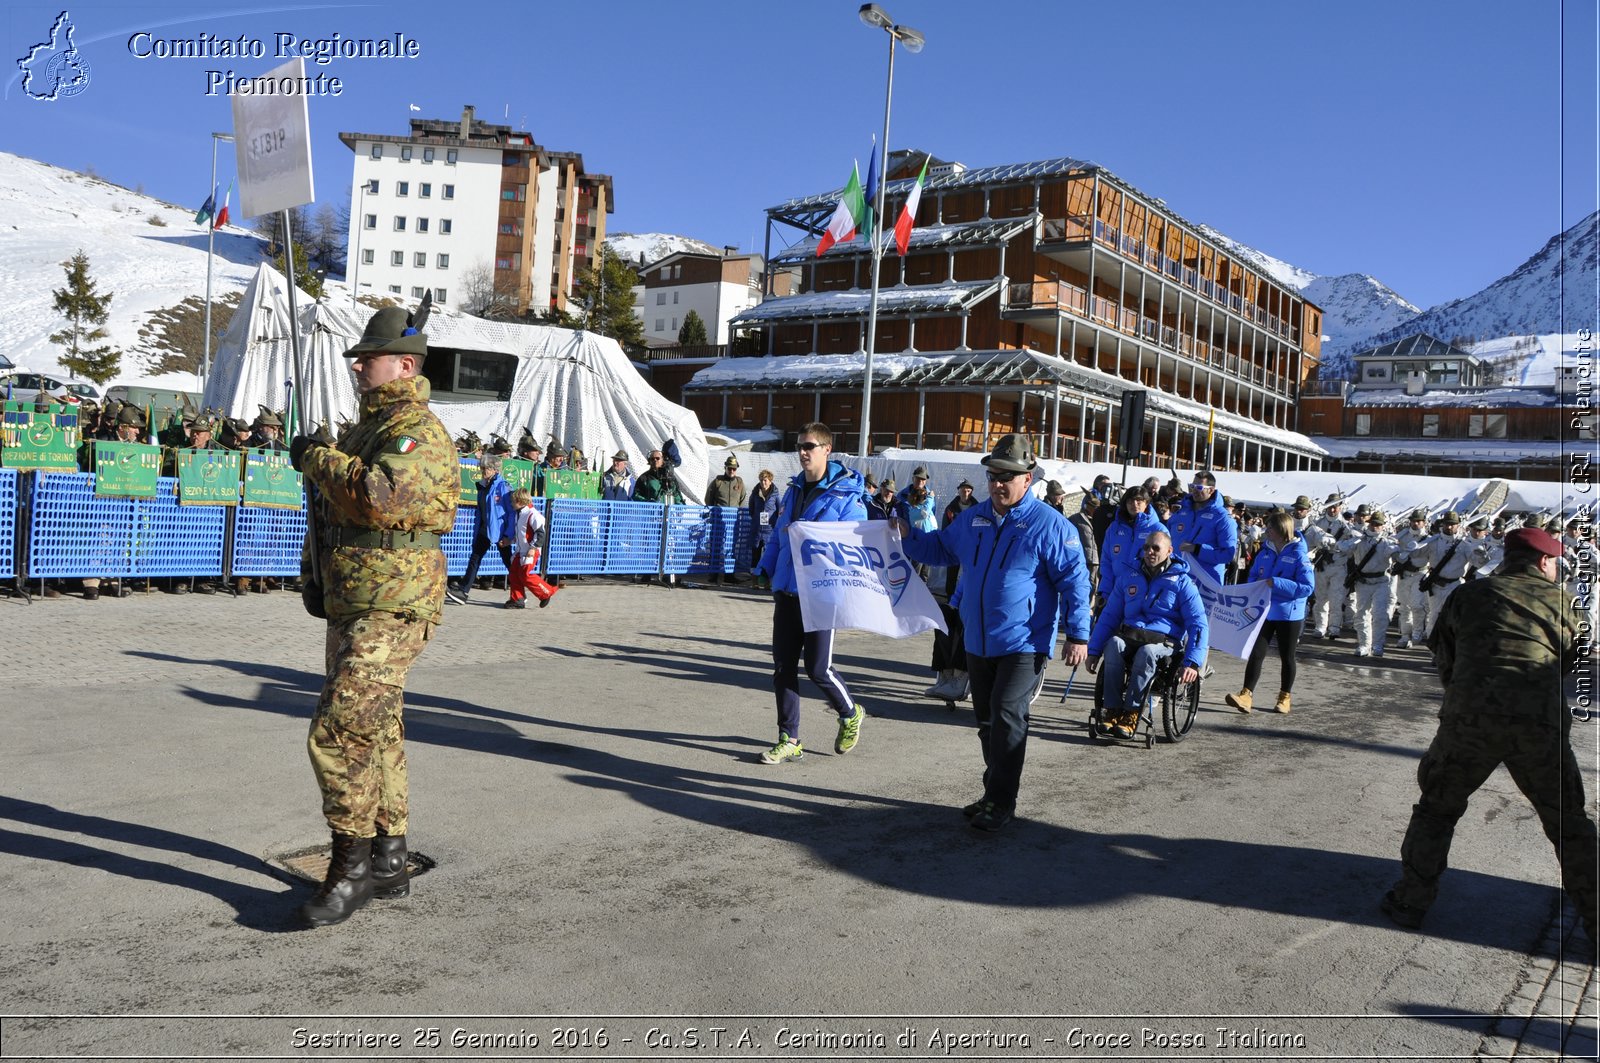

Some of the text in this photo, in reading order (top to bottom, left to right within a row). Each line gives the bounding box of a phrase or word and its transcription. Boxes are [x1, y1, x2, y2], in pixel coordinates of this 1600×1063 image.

[252, 128, 285, 159] FISIP
[4, 451, 38, 462] SEZIONE
[48, 452, 74, 463] TORINO
[220, 487, 236, 496] SUSA
[800, 538, 885, 571] FISIP
[811, 578, 838, 589] SPORT
